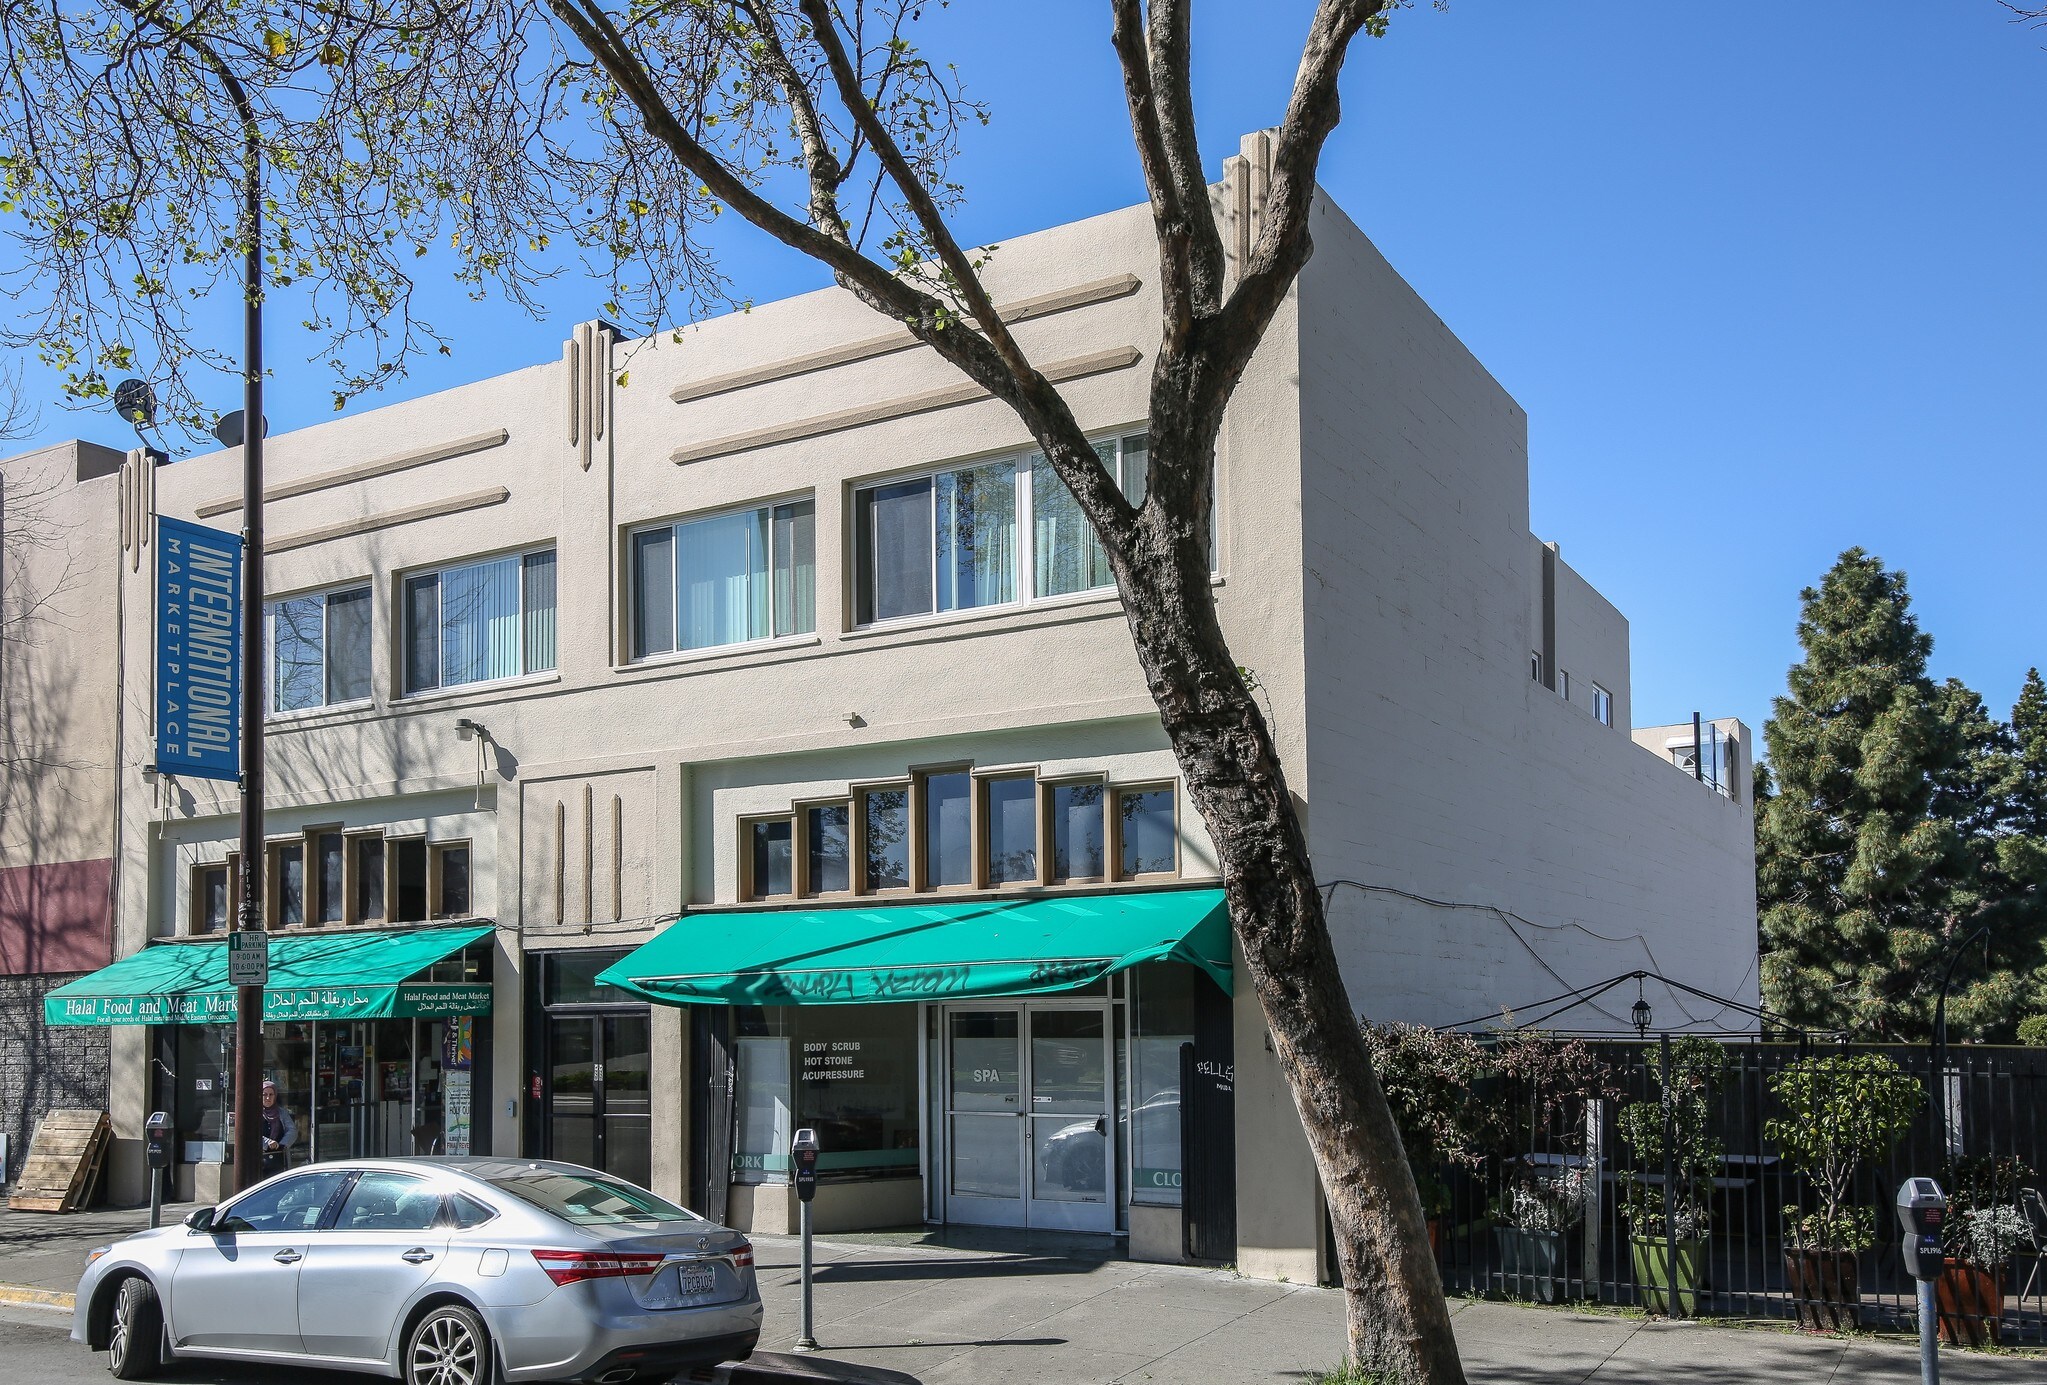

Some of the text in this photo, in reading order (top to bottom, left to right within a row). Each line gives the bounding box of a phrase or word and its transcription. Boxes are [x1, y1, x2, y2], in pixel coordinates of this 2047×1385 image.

[166, 537, 181, 755] MARKETPLACE
[187, 542, 233, 758] INTERNATIONAL
[233, 935, 238, 949] 1
[256, 962, 265, 970] PM
[268, 992, 295, 1009] الحلال
[298, 990, 319, 1011] اللحم
[348, 990, 369, 1006] محل
[404, 992, 490, 1001] Halal Food and Meat Market
[65, 999, 96, 1016] Halal
[103, 998, 133, 1015] Food
[139, 997, 160, 1014] and
[166, 997, 198, 1014] Meat
[111, 1016, 122, 1024] your
[803, 1042, 860, 1052] BODY SCRUB
[804, 1056, 853, 1066] HOT STONE
[802, 1070, 864, 1080] ACUPRESSURE
[973, 1069, 1000, 1083] SPA
[682, 1275, 713, 1290] 7PCB109
